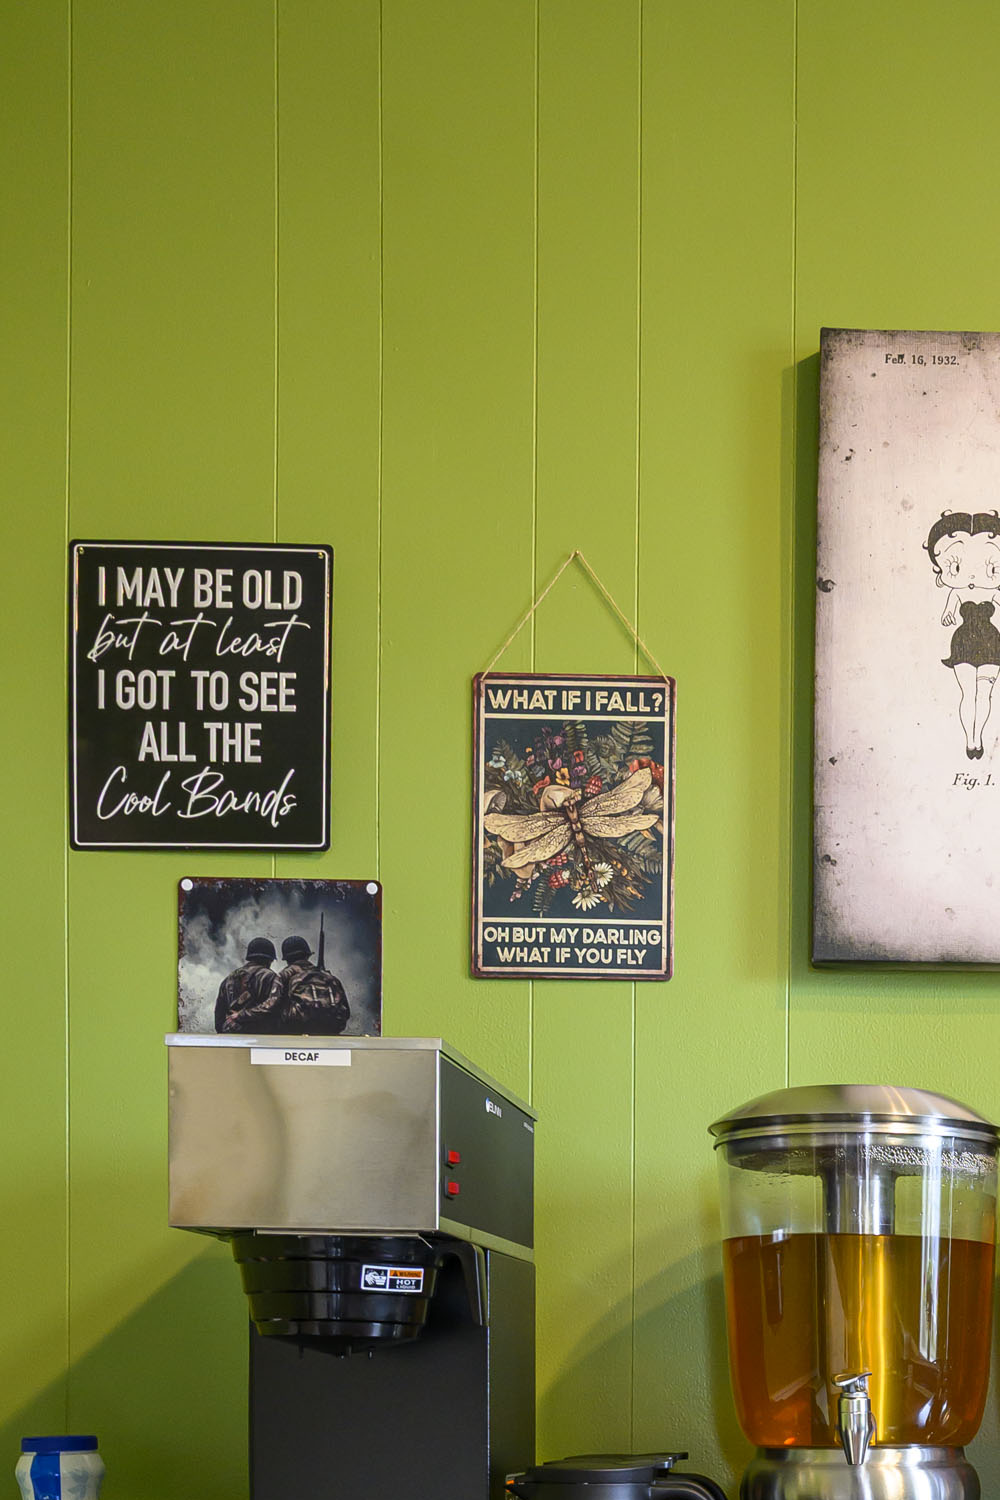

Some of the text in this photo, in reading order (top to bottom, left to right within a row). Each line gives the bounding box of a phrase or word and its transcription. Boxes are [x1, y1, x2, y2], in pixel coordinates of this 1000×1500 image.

[884, 353, 960, 367] Feb. 16, 1932.
[98, 566, 303, 611] I MAY BE OLD
[87, 611, 311, 664] but at least
[98, 669, 297, 713] I GOT TO SEE
[487, 688, 664, 714] WHAT IF I FALL?
[137, 721, 263, 764] ALL THE
[952, 772, 996, 791] Fig. 1.
[96, 765, 297, 829] Cool Bands
[483, 926, 662, 947] OH BUT MY DARLING
[496, 946, 648, 966] WHAT IF YOU FLY
[284, 1052, 320, 1062] DECAF
